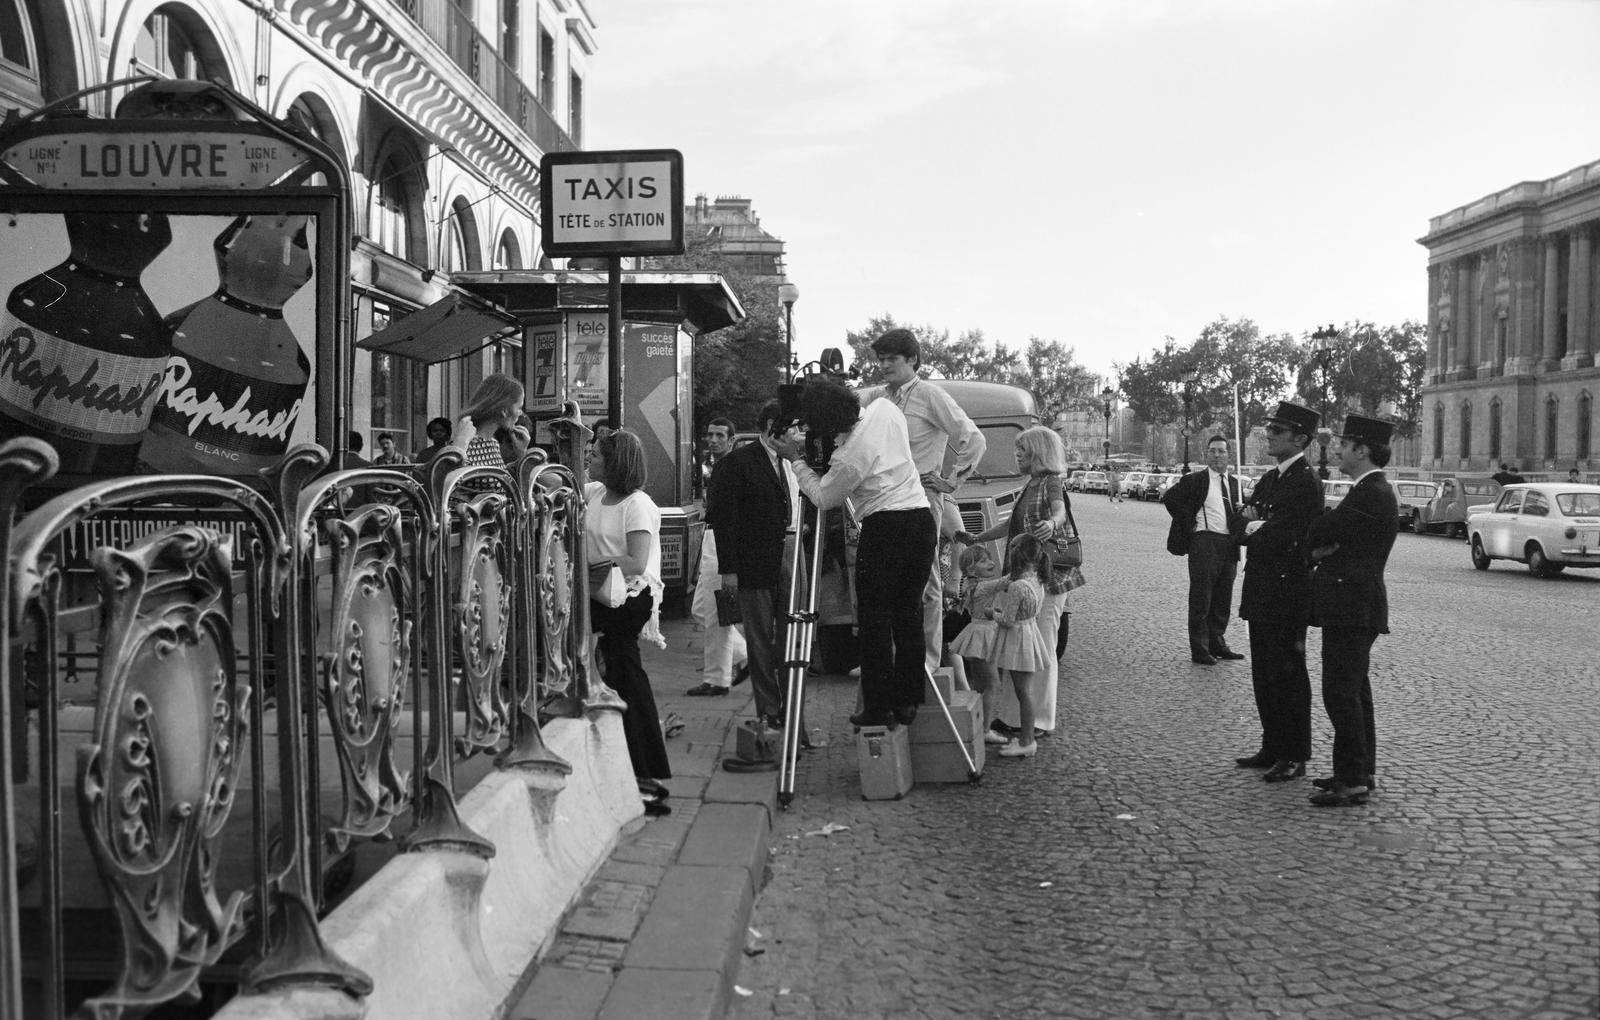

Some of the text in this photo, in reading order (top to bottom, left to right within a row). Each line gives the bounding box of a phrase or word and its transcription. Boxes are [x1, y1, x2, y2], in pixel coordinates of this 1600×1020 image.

[29, 148, 61, 160] LIGNE
[80, 144, 228, 177] LOUVRE
[245, 147, 277, 160] LIGNE
[564, 176, 657, 200] TAXIS
[559, 212, 665, 228] TÊTE DE STATION
[641, 332, 674, 344] succès
[61, 427, 94, 441] export
[194, 441, 241, 462] BLANC
[82, 516, 178, 560] TÉLÉPH
